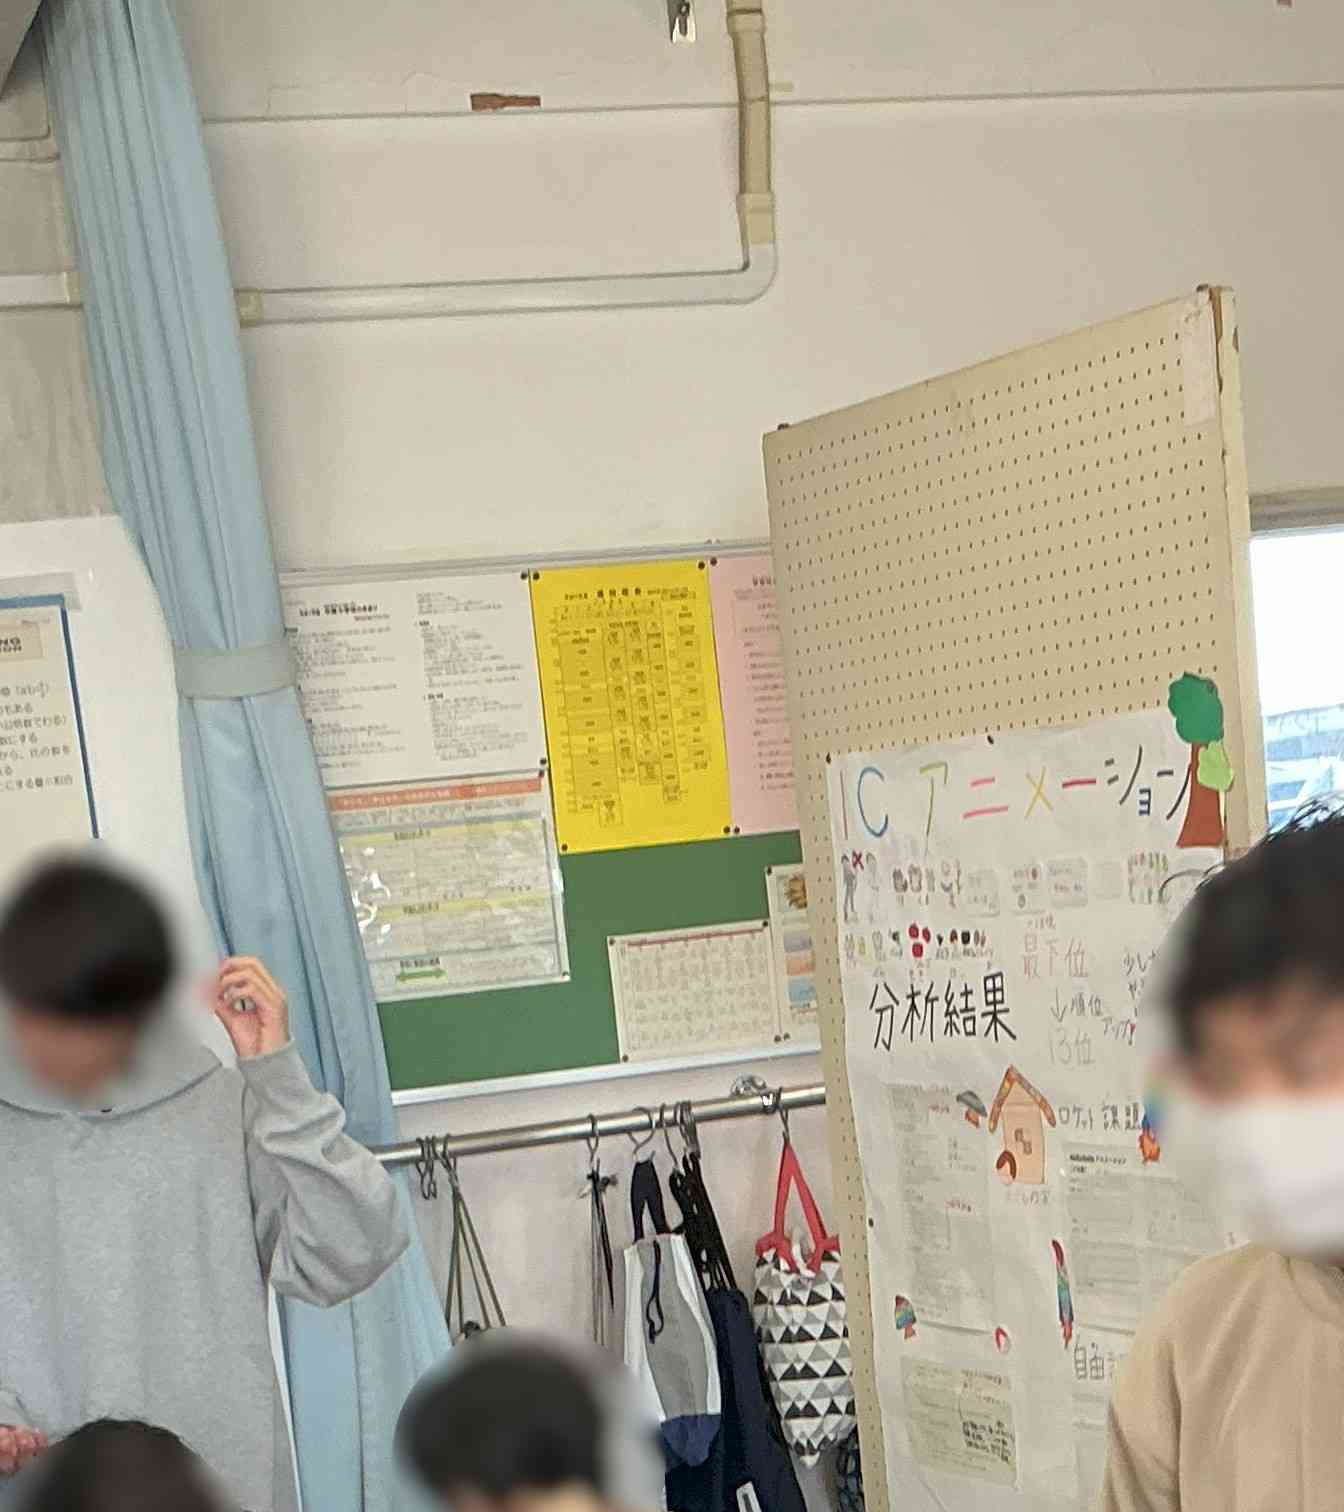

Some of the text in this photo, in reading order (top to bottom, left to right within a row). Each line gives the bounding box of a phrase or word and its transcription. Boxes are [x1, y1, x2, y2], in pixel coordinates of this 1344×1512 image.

[919, 745, 1193, 858] アニメーション
[869, 971, 1018, 1052] 分析結果
